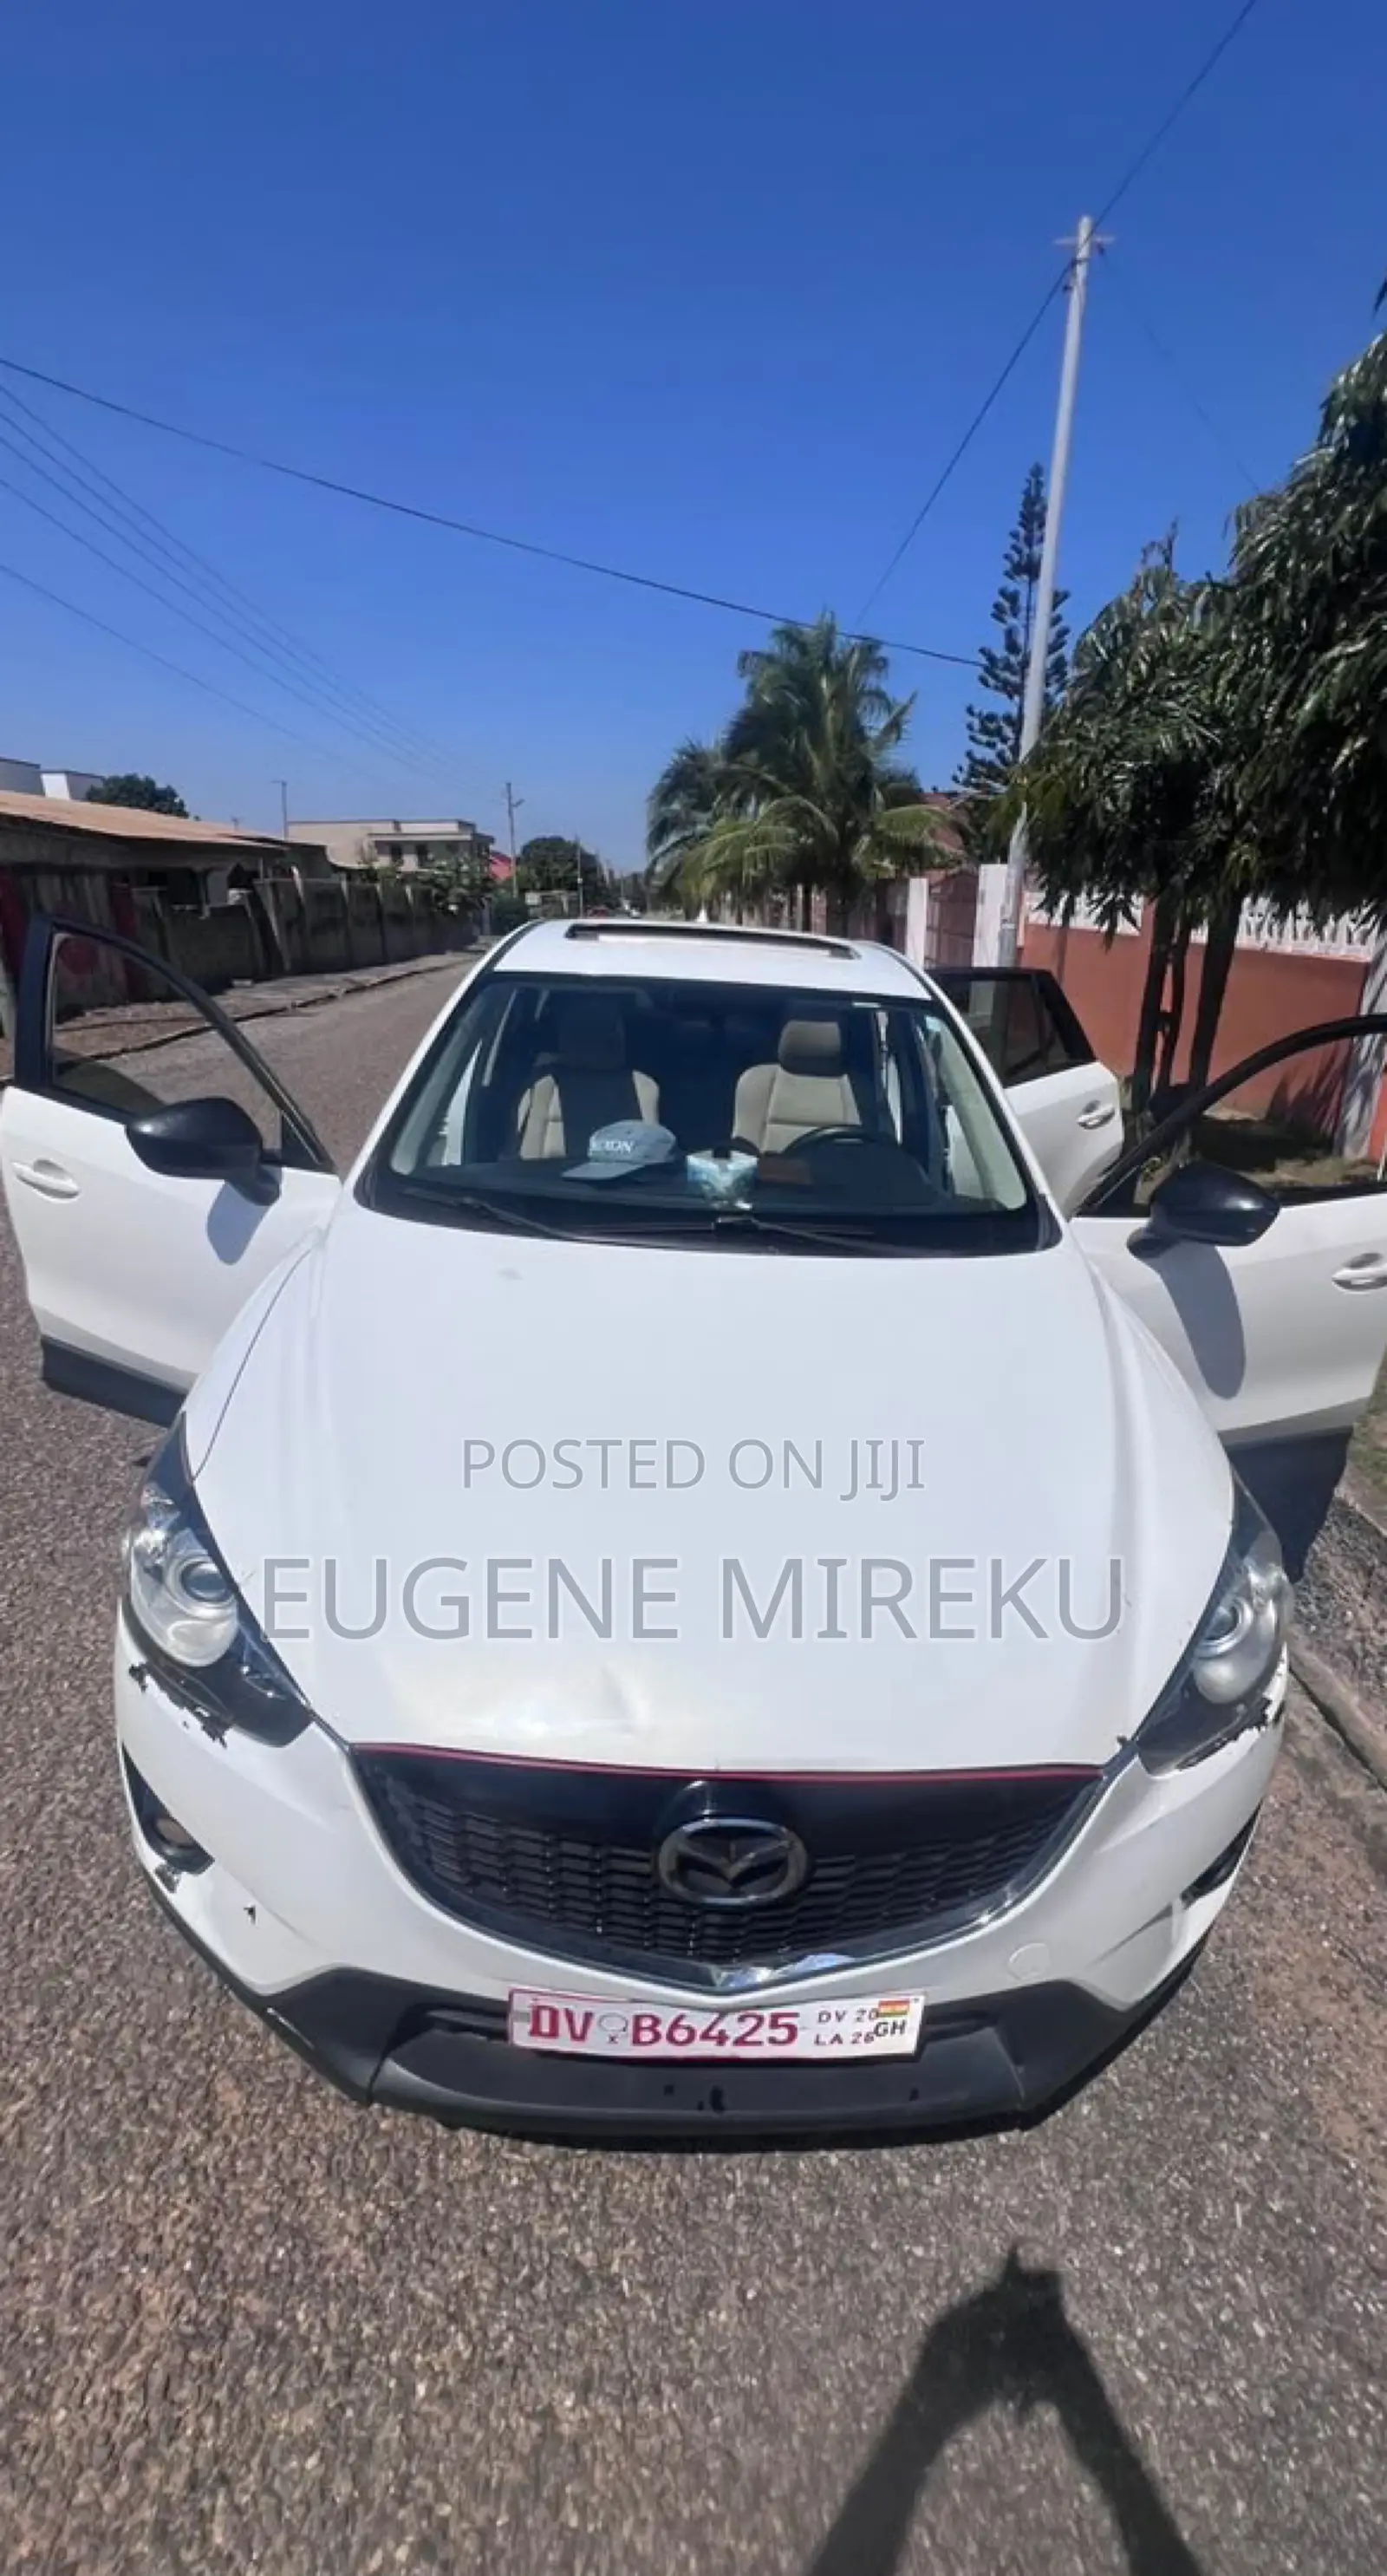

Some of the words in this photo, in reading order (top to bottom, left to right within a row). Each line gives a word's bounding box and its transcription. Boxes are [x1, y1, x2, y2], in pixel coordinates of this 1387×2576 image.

[817, 2009, 847, 2024] DV
[855, 2007, 879, 2023] 20
[529, 2005, 594, 2043] DV
[631, 2012, 800, 2047] B6425
[873, 2020, 907, 2038] GH
[813, 2033, 843, 2046] LA
